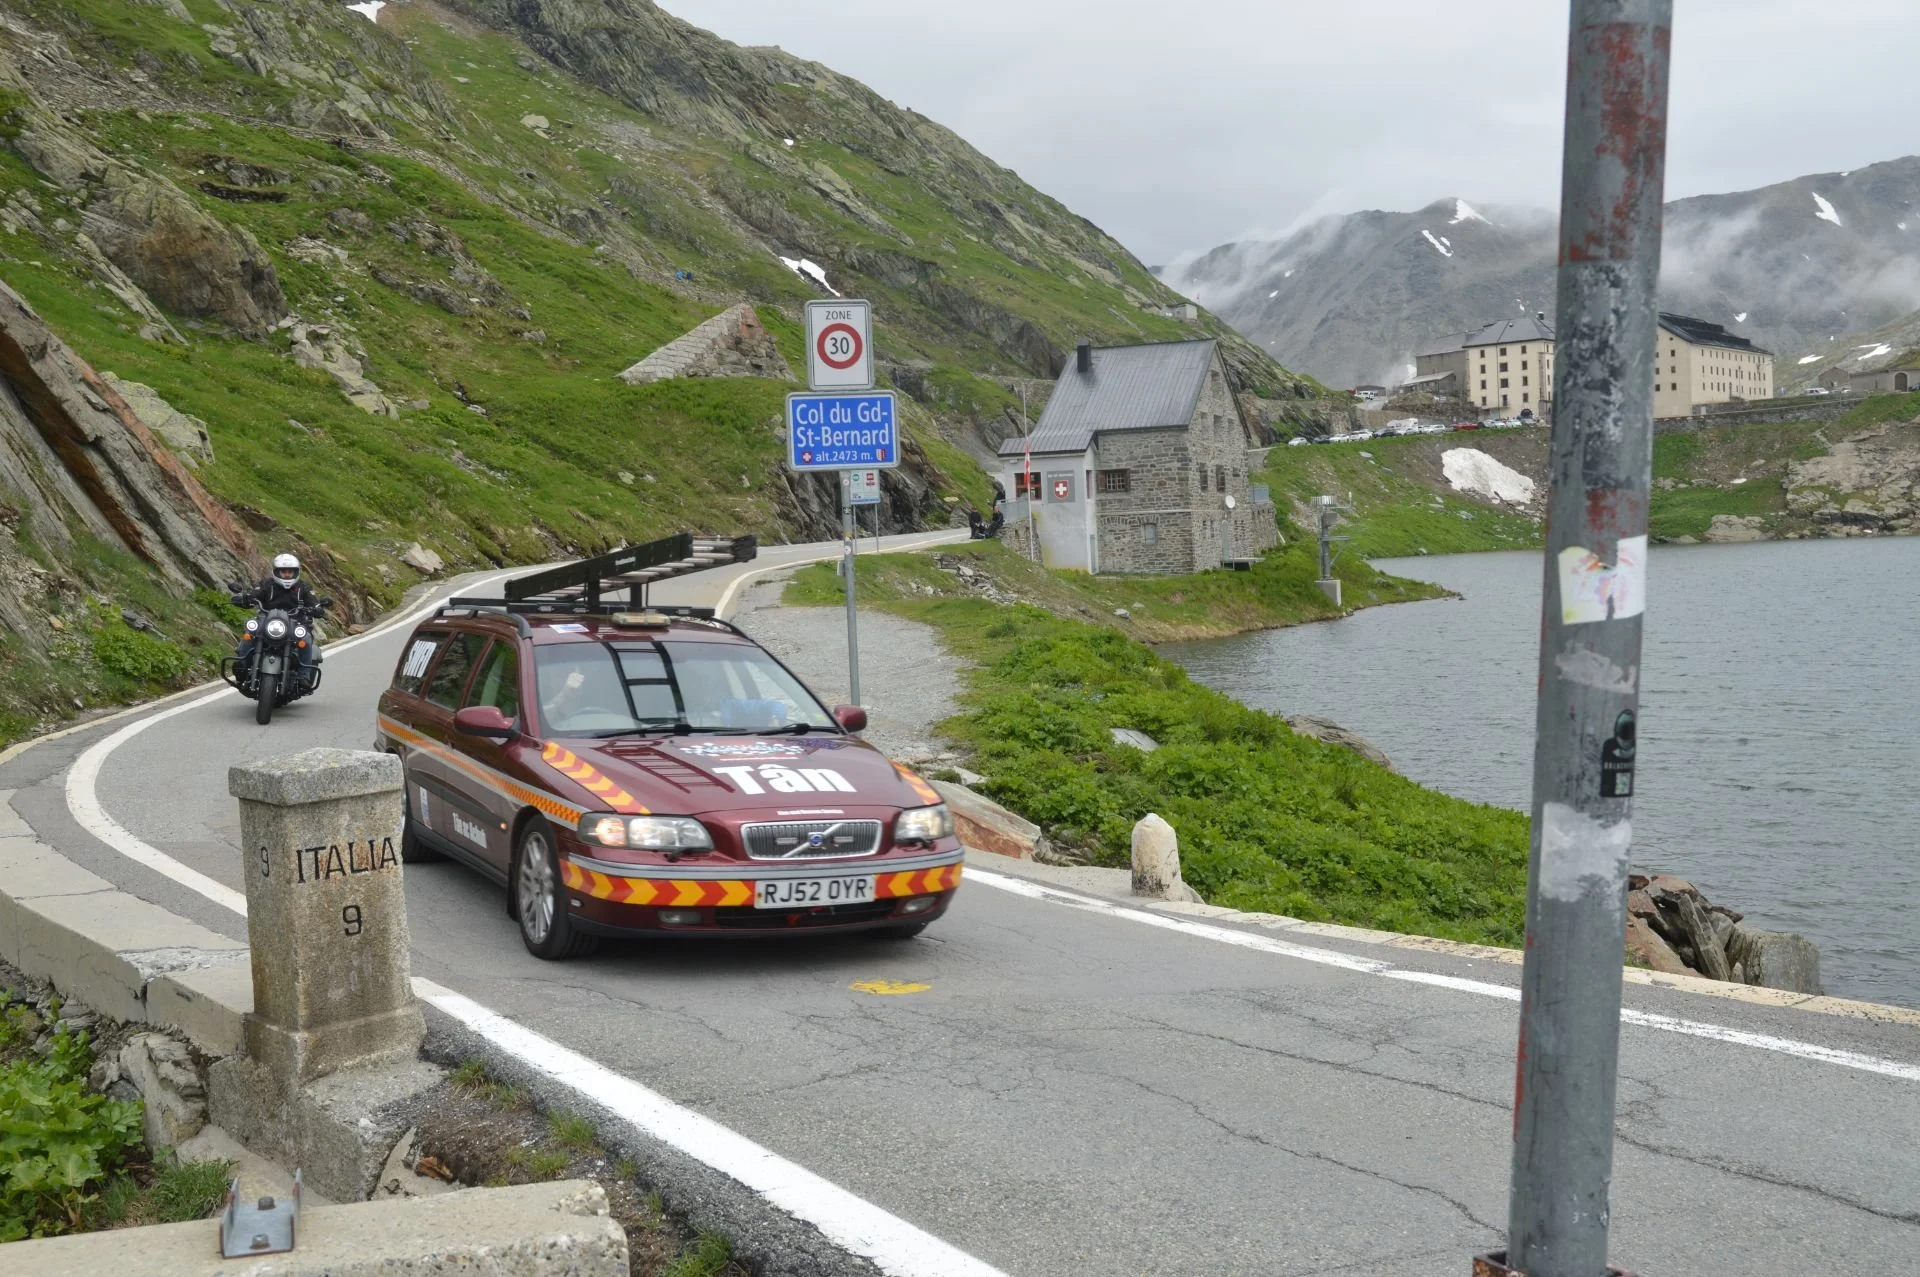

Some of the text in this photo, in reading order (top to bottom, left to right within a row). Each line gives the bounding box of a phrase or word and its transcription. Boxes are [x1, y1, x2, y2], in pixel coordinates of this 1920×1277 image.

[825, 310, 852, 320] ZONE
[830, 337, 849, 355] 30
[796, 400, 888, 425] Col du Gd-
[796, 423, 889, 448] St-Bernard
[712, 763, 857, 795] Tân
[260, 846, 270, 878] 9
[296, 837, 398, 883] ITALIA
[764, 878, 867, 904] RJ52 OYR
[343, 905, 363, 936] 9
